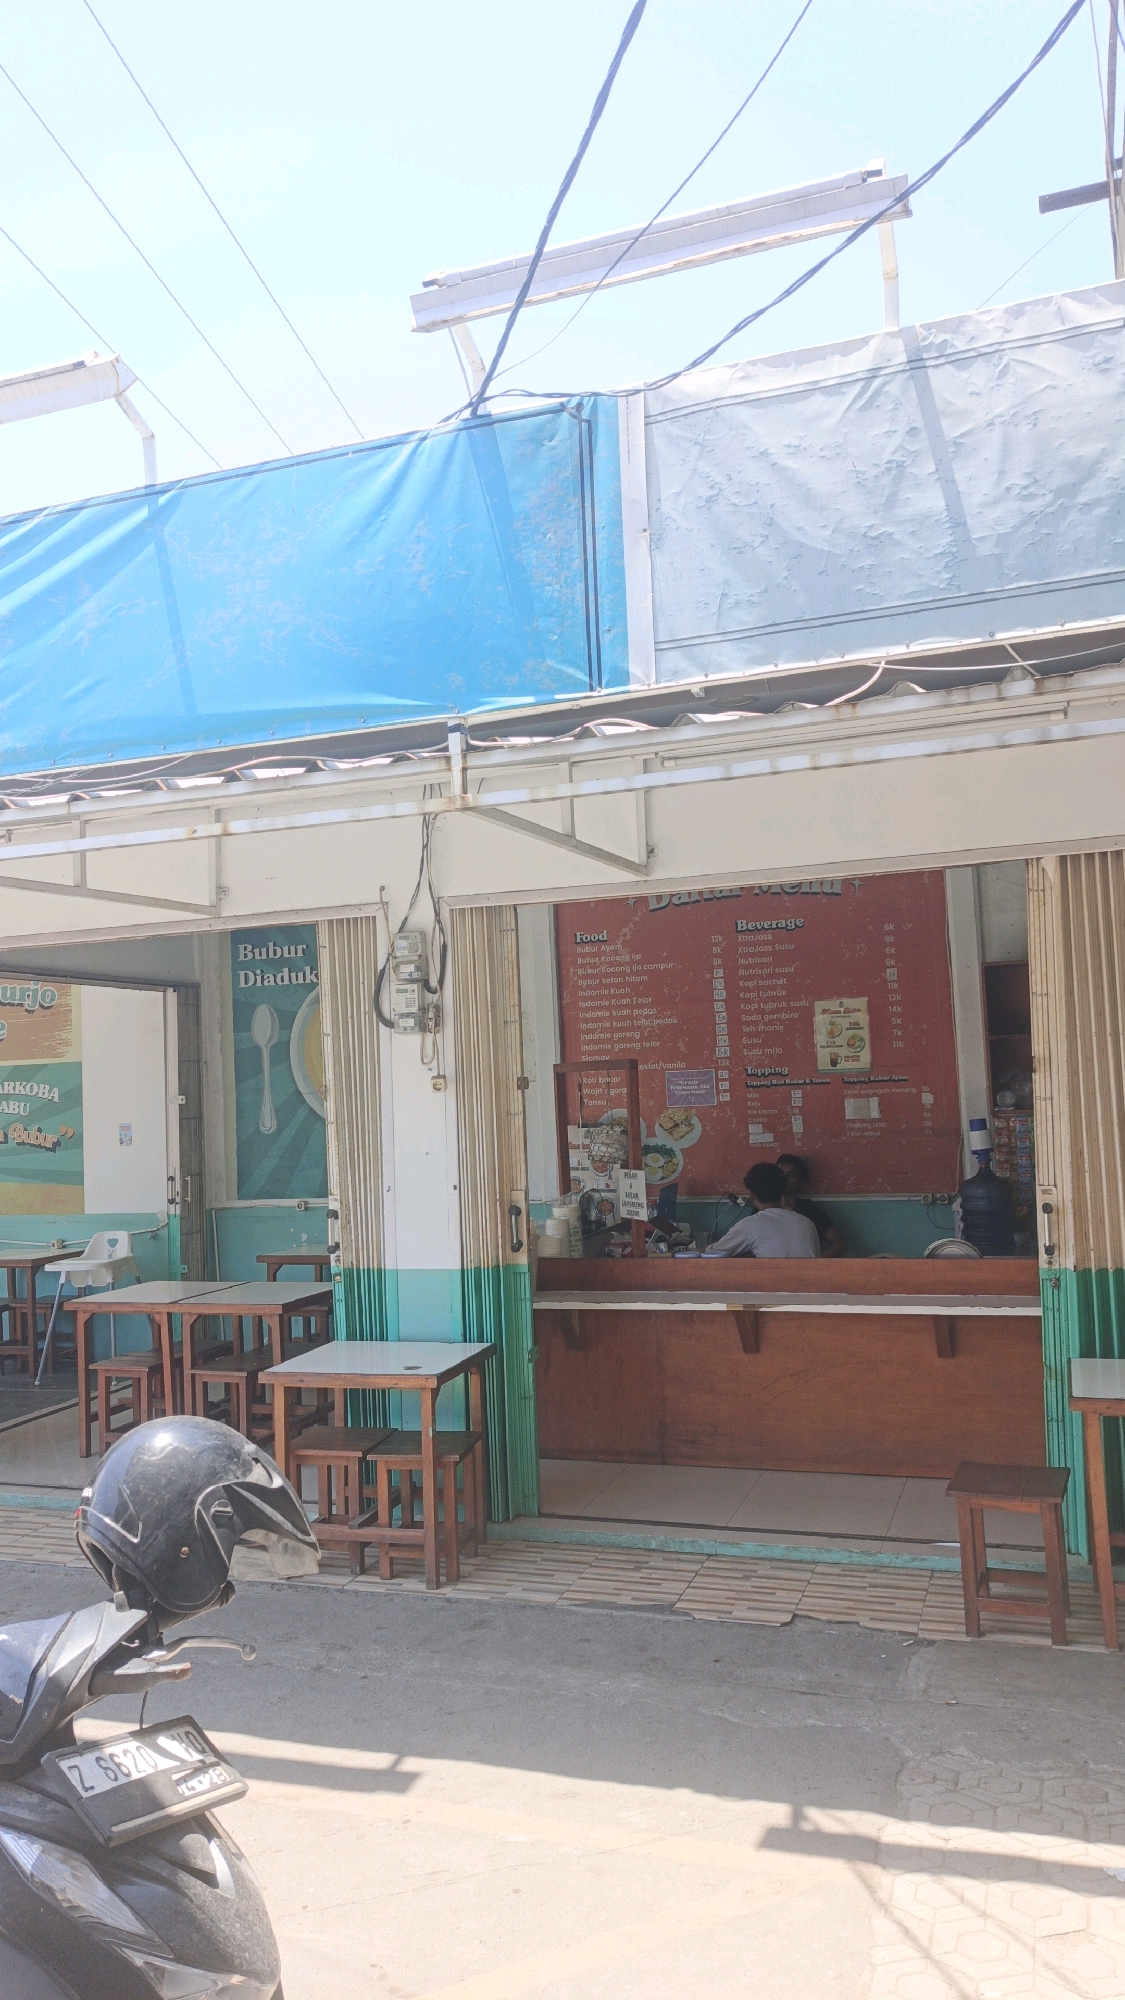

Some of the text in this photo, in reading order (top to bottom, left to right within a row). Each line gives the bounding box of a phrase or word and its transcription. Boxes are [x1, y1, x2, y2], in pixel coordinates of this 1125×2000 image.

[737, 918, 804, 932] Beverage
[575, 930, 607, 944] Food
[884, 935, 895, 943] 9k
[237, 942, 307, 962] Bubur
[576, 944, 623, 954] Bubur Ayam
[577, 956, 600, 965] Bubur
[601, 954, 630, 963] Kacang
[738, 956, 773, 965] Nutrisari
[577, 967, 600, 976] Bubur
[601, 964, 631, 974] Kacang
[643, 962, 674, 972] campur
[738, 967, 773, 977] Nutrisari
[237, 966, 319, 988] Diaduk
[578, 974, 648, 986] Bubur ketan hitam
[739, 979, 757, 988] Kopi
[887, 982, 899, 990] 11k
[578, 987, 631, 997] Indomie Kuah
[740, 990, 787, 1000] Kopi tubruk
[888, 993, 902, 1001] 13k
[579, 999, 610, 1009] Indomie
[611, 998, 632, 1006] Kuah
[740, 1002, 759, 1012] Kopi
[760, 1001, 787, 1009] tubruk
[579, 1008, 658, 1019] Indomie kuah pedas
[889, 1005, 903, 1013] 14k
[741, 1014, 762, 1022] Soda
[891, 1017, 902, 1025] 5k
[580, 1021, 611, 1030] Indomie
[612, 1020, 632, 1028] kuah
[742, 1024, 784, 1033] Teh manis
[580, 1030, 641, 1041] Indomie goreng
[892, 1029, 903, 1037] 7k
[742, 1036, 762, 1044] Susu
[893, 1041, 905, 1049] 11k
[581, 1043, 612, 1052] Indomie
[614, 1042, 641, 1051] goreng
[743, 1048, 763, 1056] Susu
[746, 1066, 789, 1077] Topping
[67, 1764, 96, 1793] Z
[95, 1745, 159, 1782] 6620
